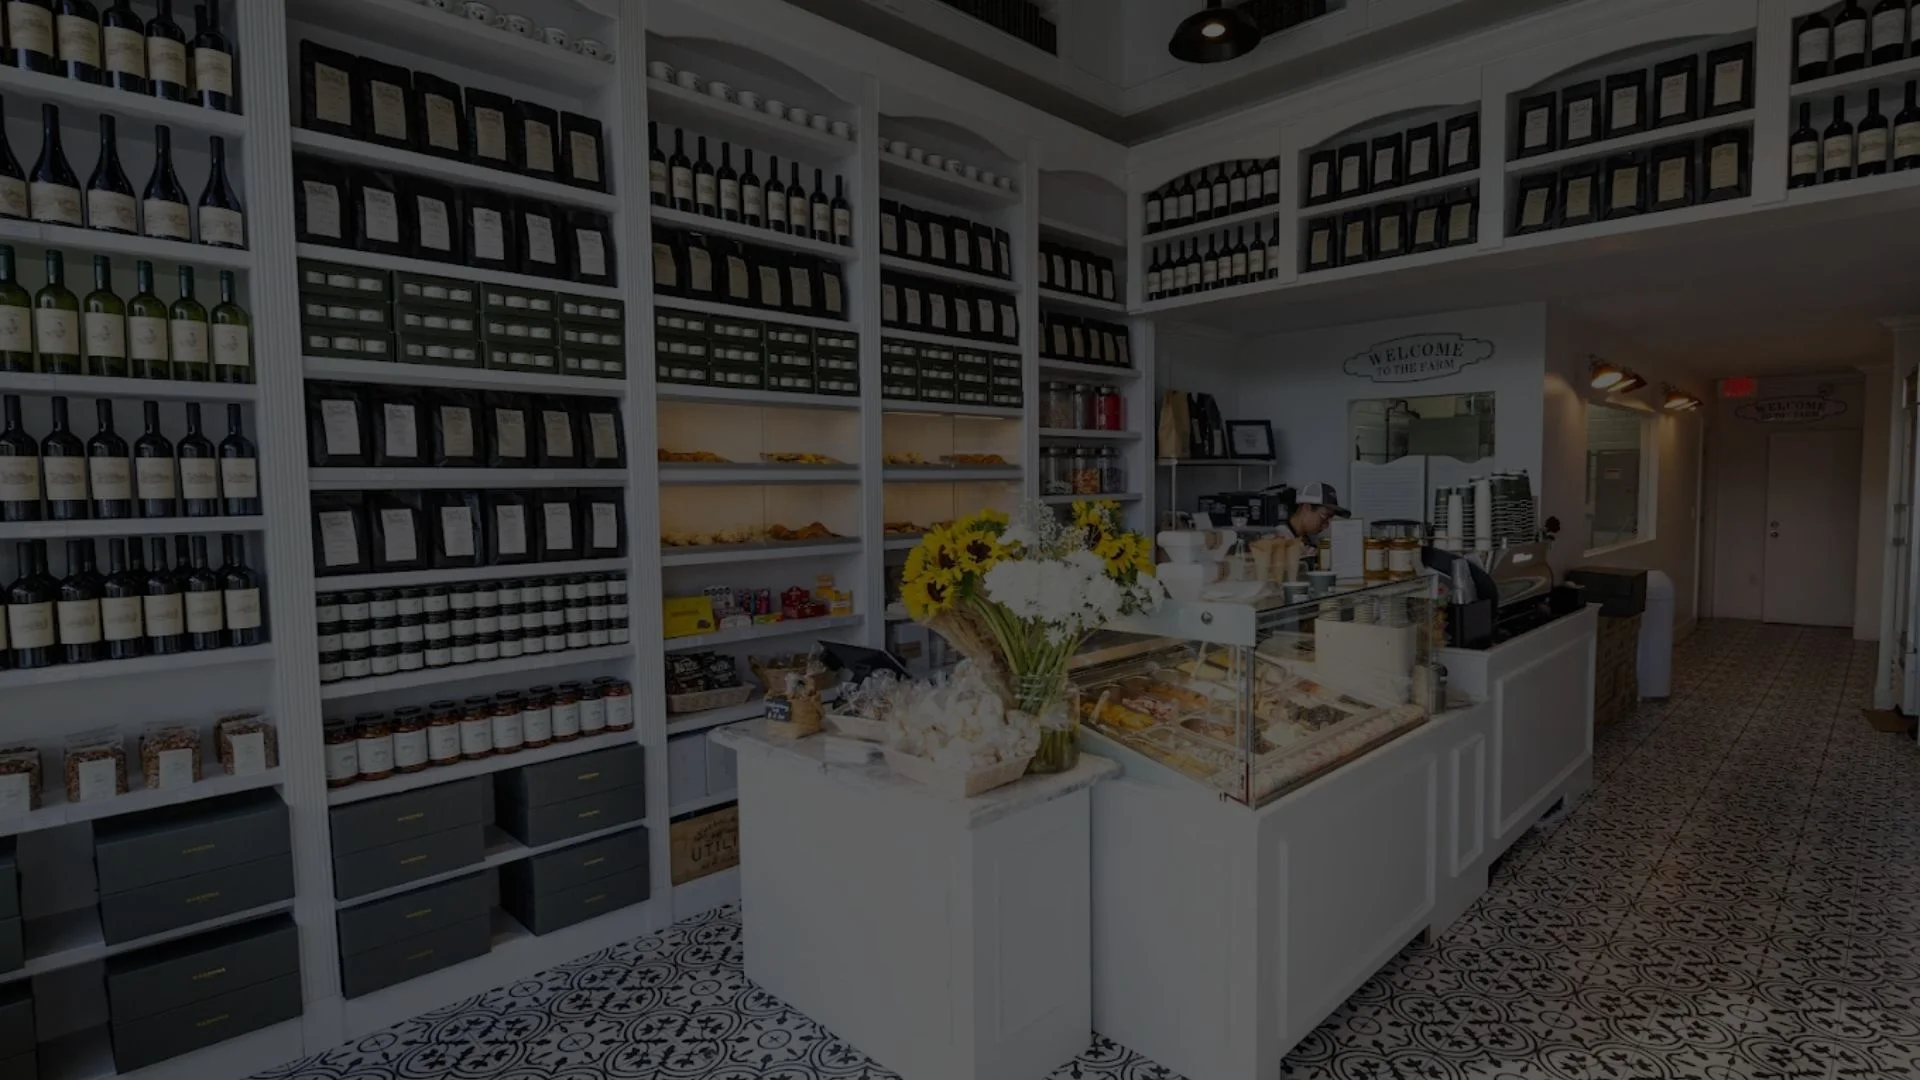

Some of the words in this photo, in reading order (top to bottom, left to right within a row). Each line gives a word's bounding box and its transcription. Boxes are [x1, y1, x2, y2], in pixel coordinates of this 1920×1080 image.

[1368, 342, 1464, 366] WELCOME
[1376, 366, 1391, 377] TO
[1393, 362, 1417, 375] THE
[1419, 358, 1455, 373] FARM
